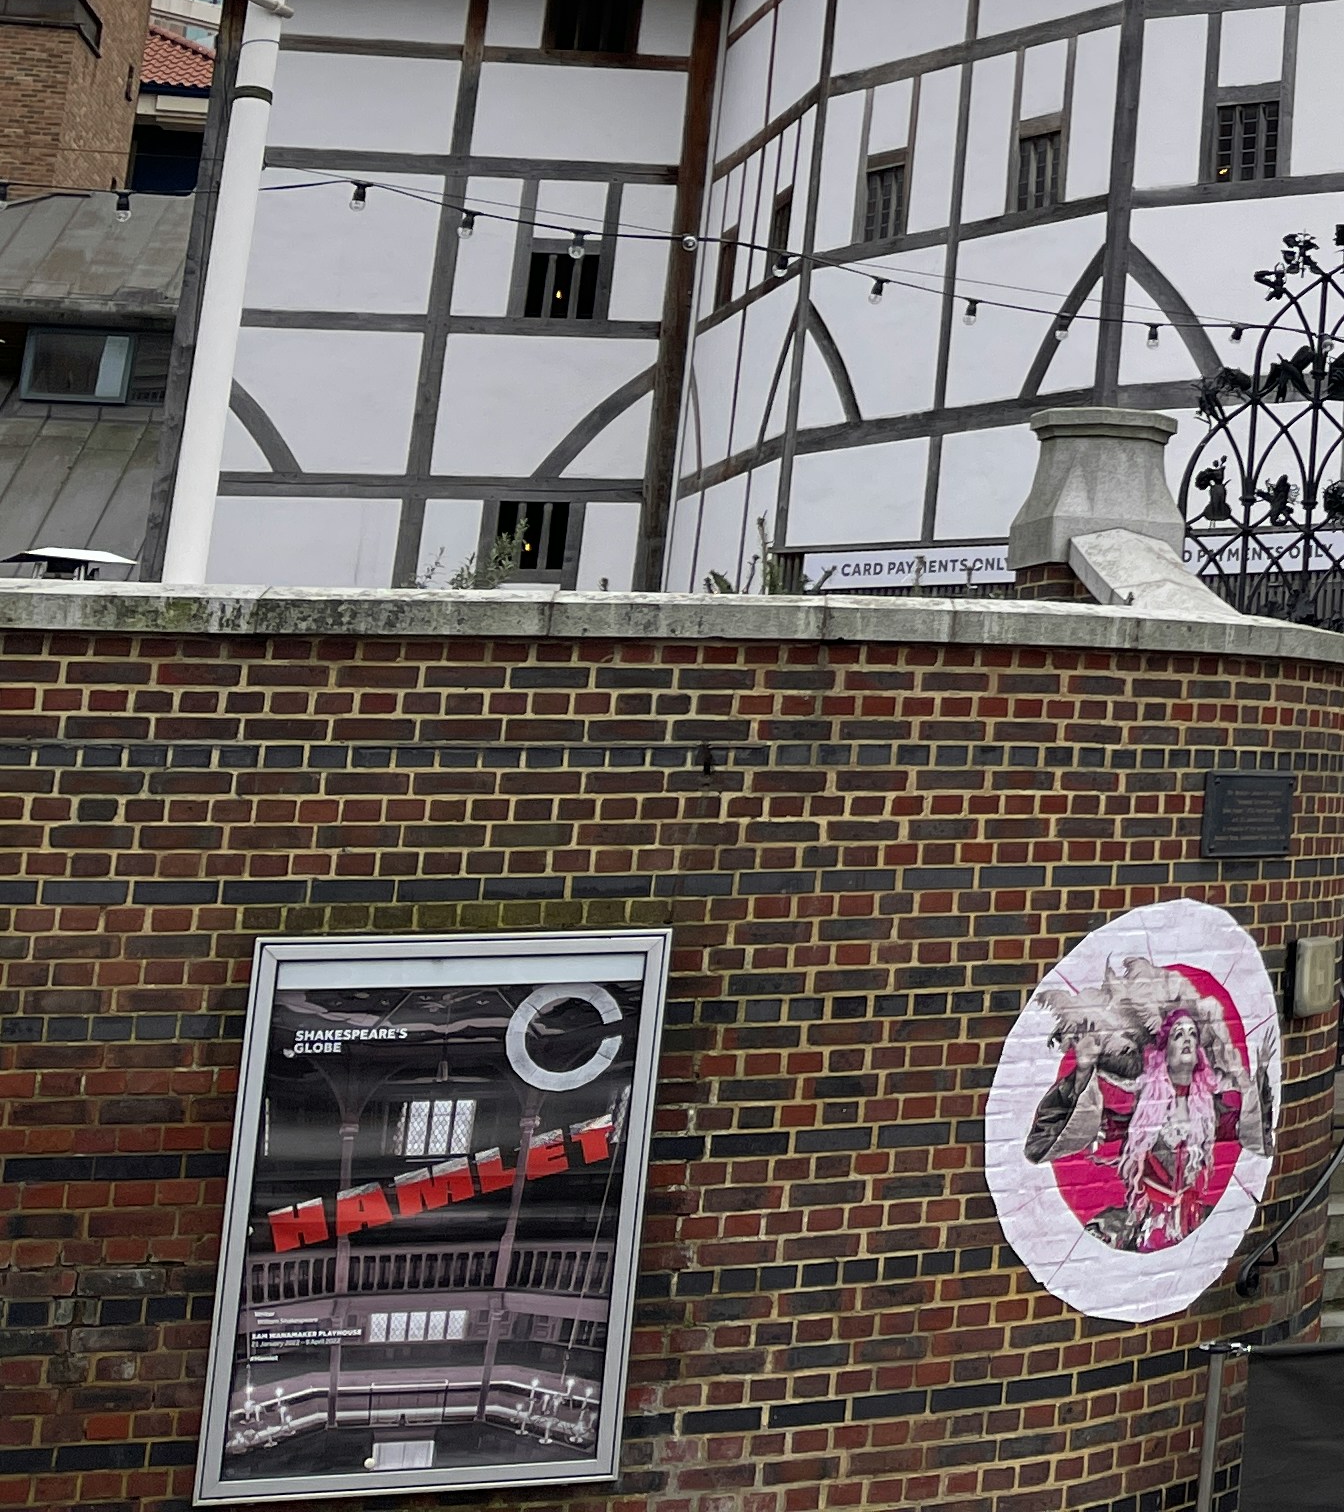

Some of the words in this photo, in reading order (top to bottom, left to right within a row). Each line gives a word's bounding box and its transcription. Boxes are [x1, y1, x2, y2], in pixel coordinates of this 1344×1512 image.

[841, 562, 883, 577] CARD
[295, 1028, 408, 1042] SHAKESPEARE'S
[294, 1042, 342, 1054] GLOBE
[268, 1114, 615, 1253] HAMLET
[318, 1328, 362, 1337] PLAYHOUSE
